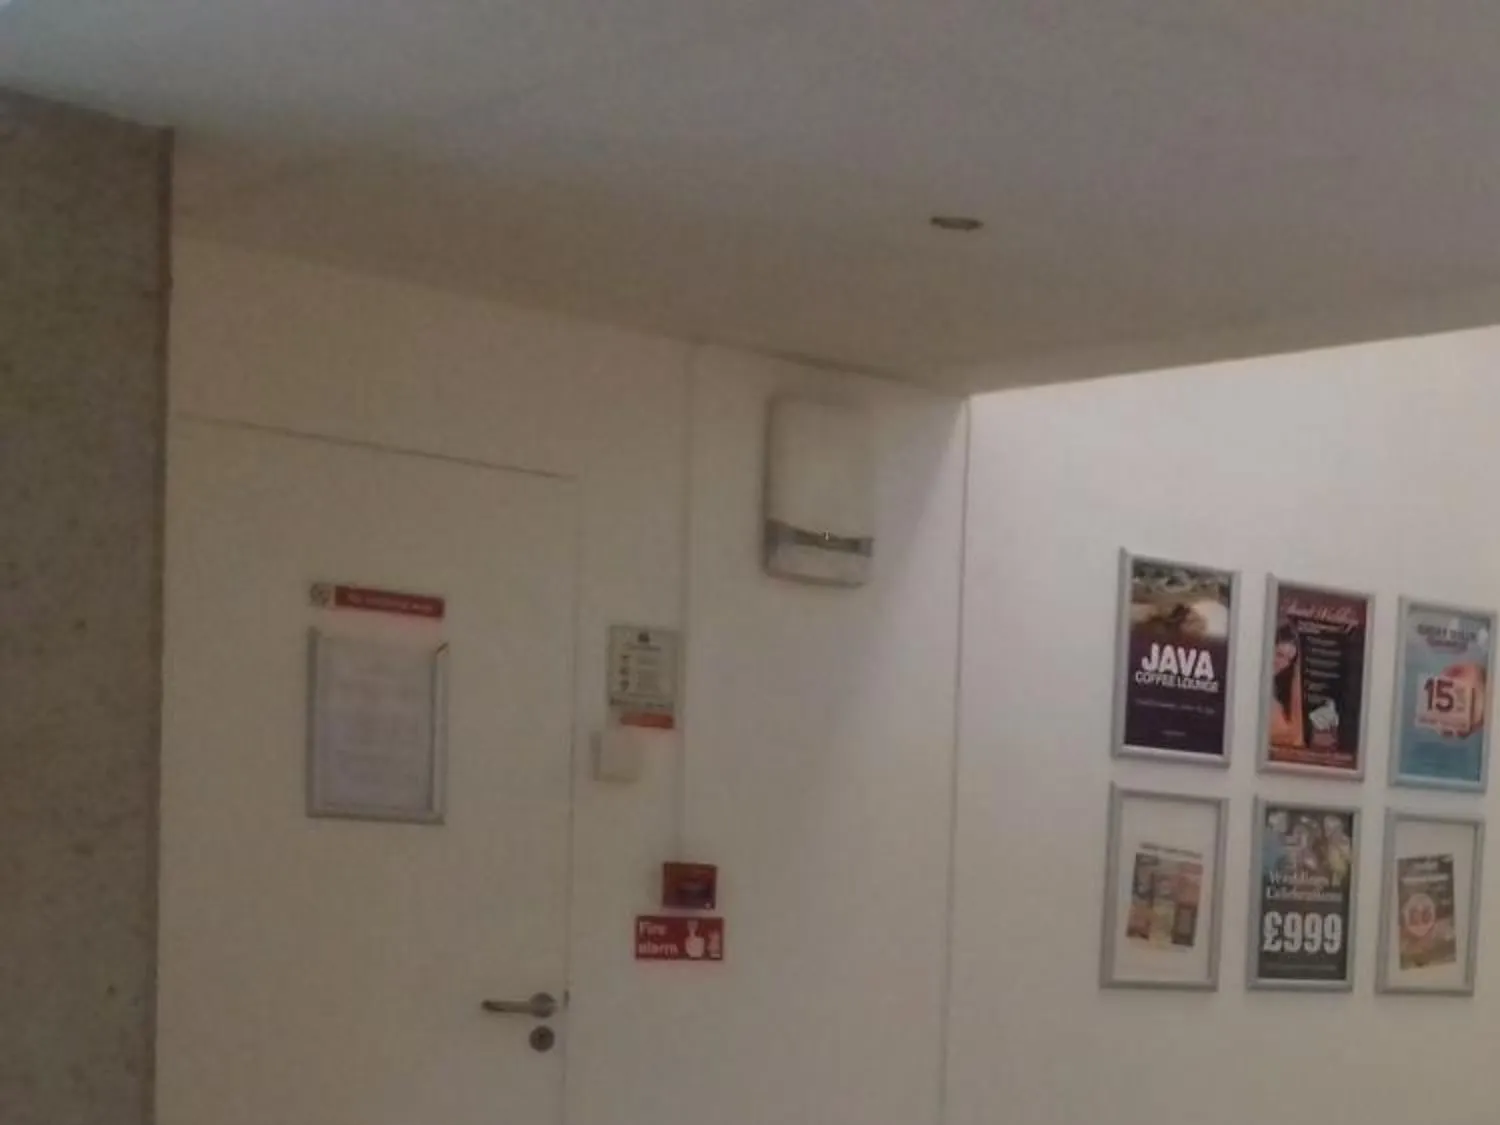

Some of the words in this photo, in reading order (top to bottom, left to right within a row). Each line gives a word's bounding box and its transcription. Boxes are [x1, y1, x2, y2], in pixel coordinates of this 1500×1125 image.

[1141, 641, 1215, 681] JAVA
[1135, 670, 1176, 688] COFFEE
[1177, 674, 1219, 693] LOUNGE
[639, 921, 668, 936] Fire
[1263, 911, 1343, 954] £999
[638, 940, 679, 956] alarm
